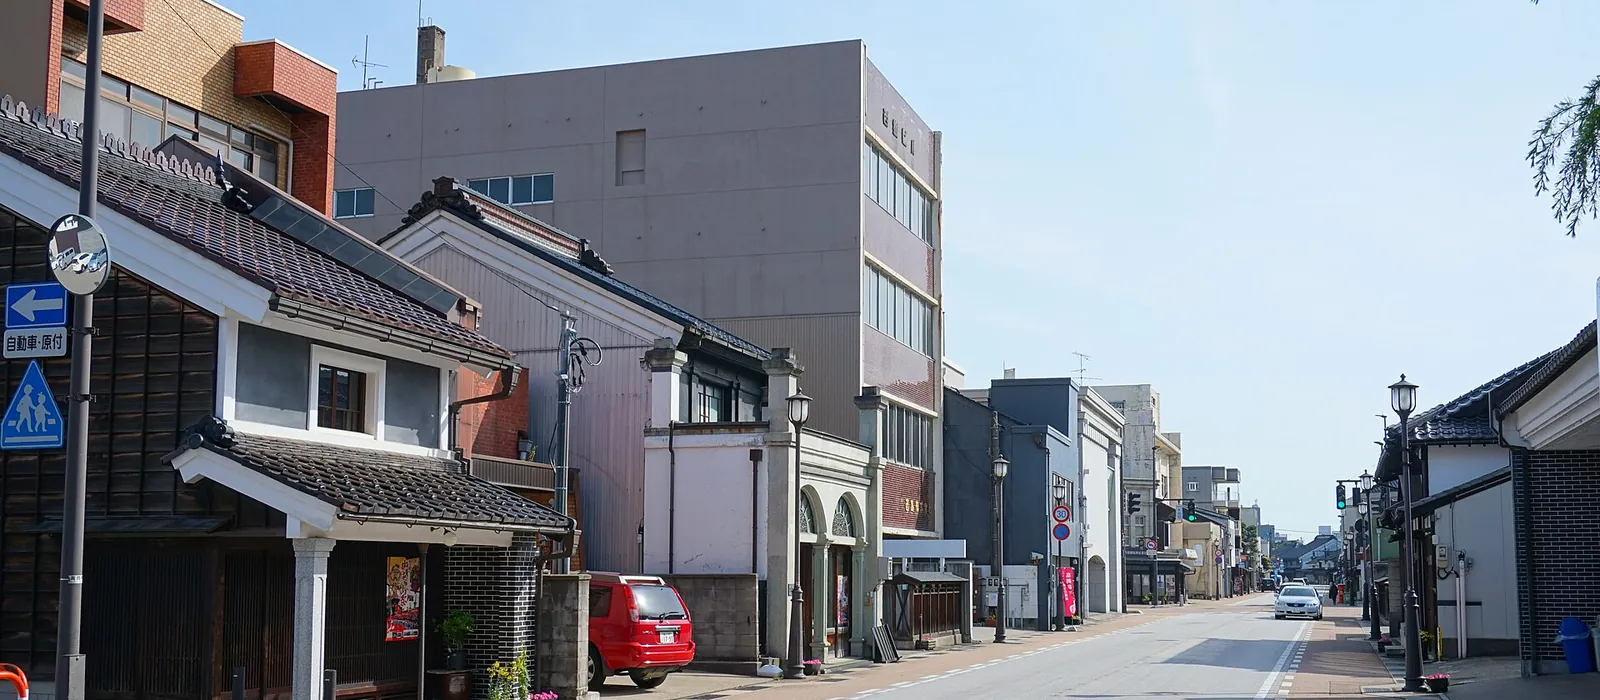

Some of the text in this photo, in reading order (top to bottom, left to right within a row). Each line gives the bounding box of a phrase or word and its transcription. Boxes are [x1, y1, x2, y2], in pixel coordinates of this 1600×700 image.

[7, 334, 62, 351] 自動車・原付
[1056, 510, 1067, 518] 30
